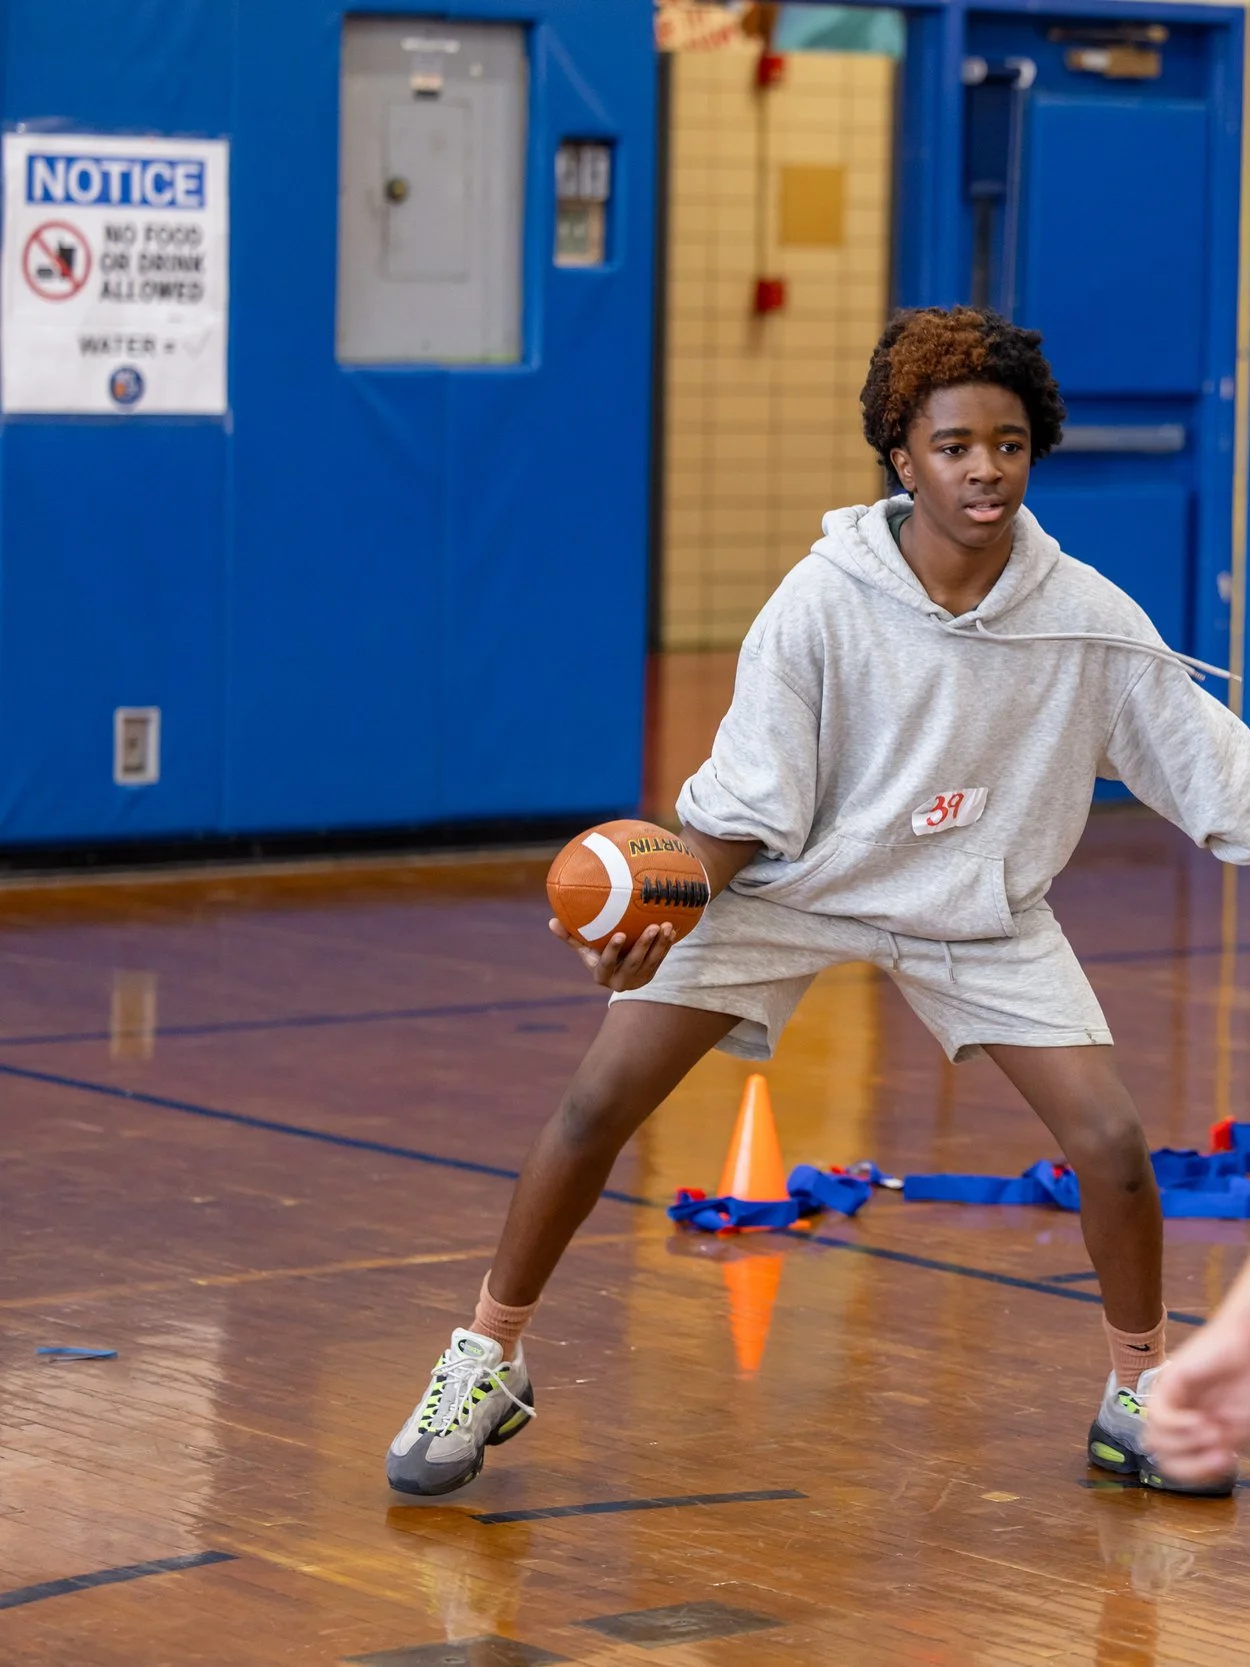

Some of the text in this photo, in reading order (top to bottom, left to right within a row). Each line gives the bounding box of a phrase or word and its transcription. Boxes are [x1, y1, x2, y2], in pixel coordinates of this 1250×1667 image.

[32, 157, 202, 206] NOTICE
[104, 224, 203, 246] NO FOOD
[101, 251, 203, 274] OR DRINK
[101, 281, 204, 302] ALLOWED
[80, 334, 156, 356] WATER
[926, 792, 965, 826] 39
